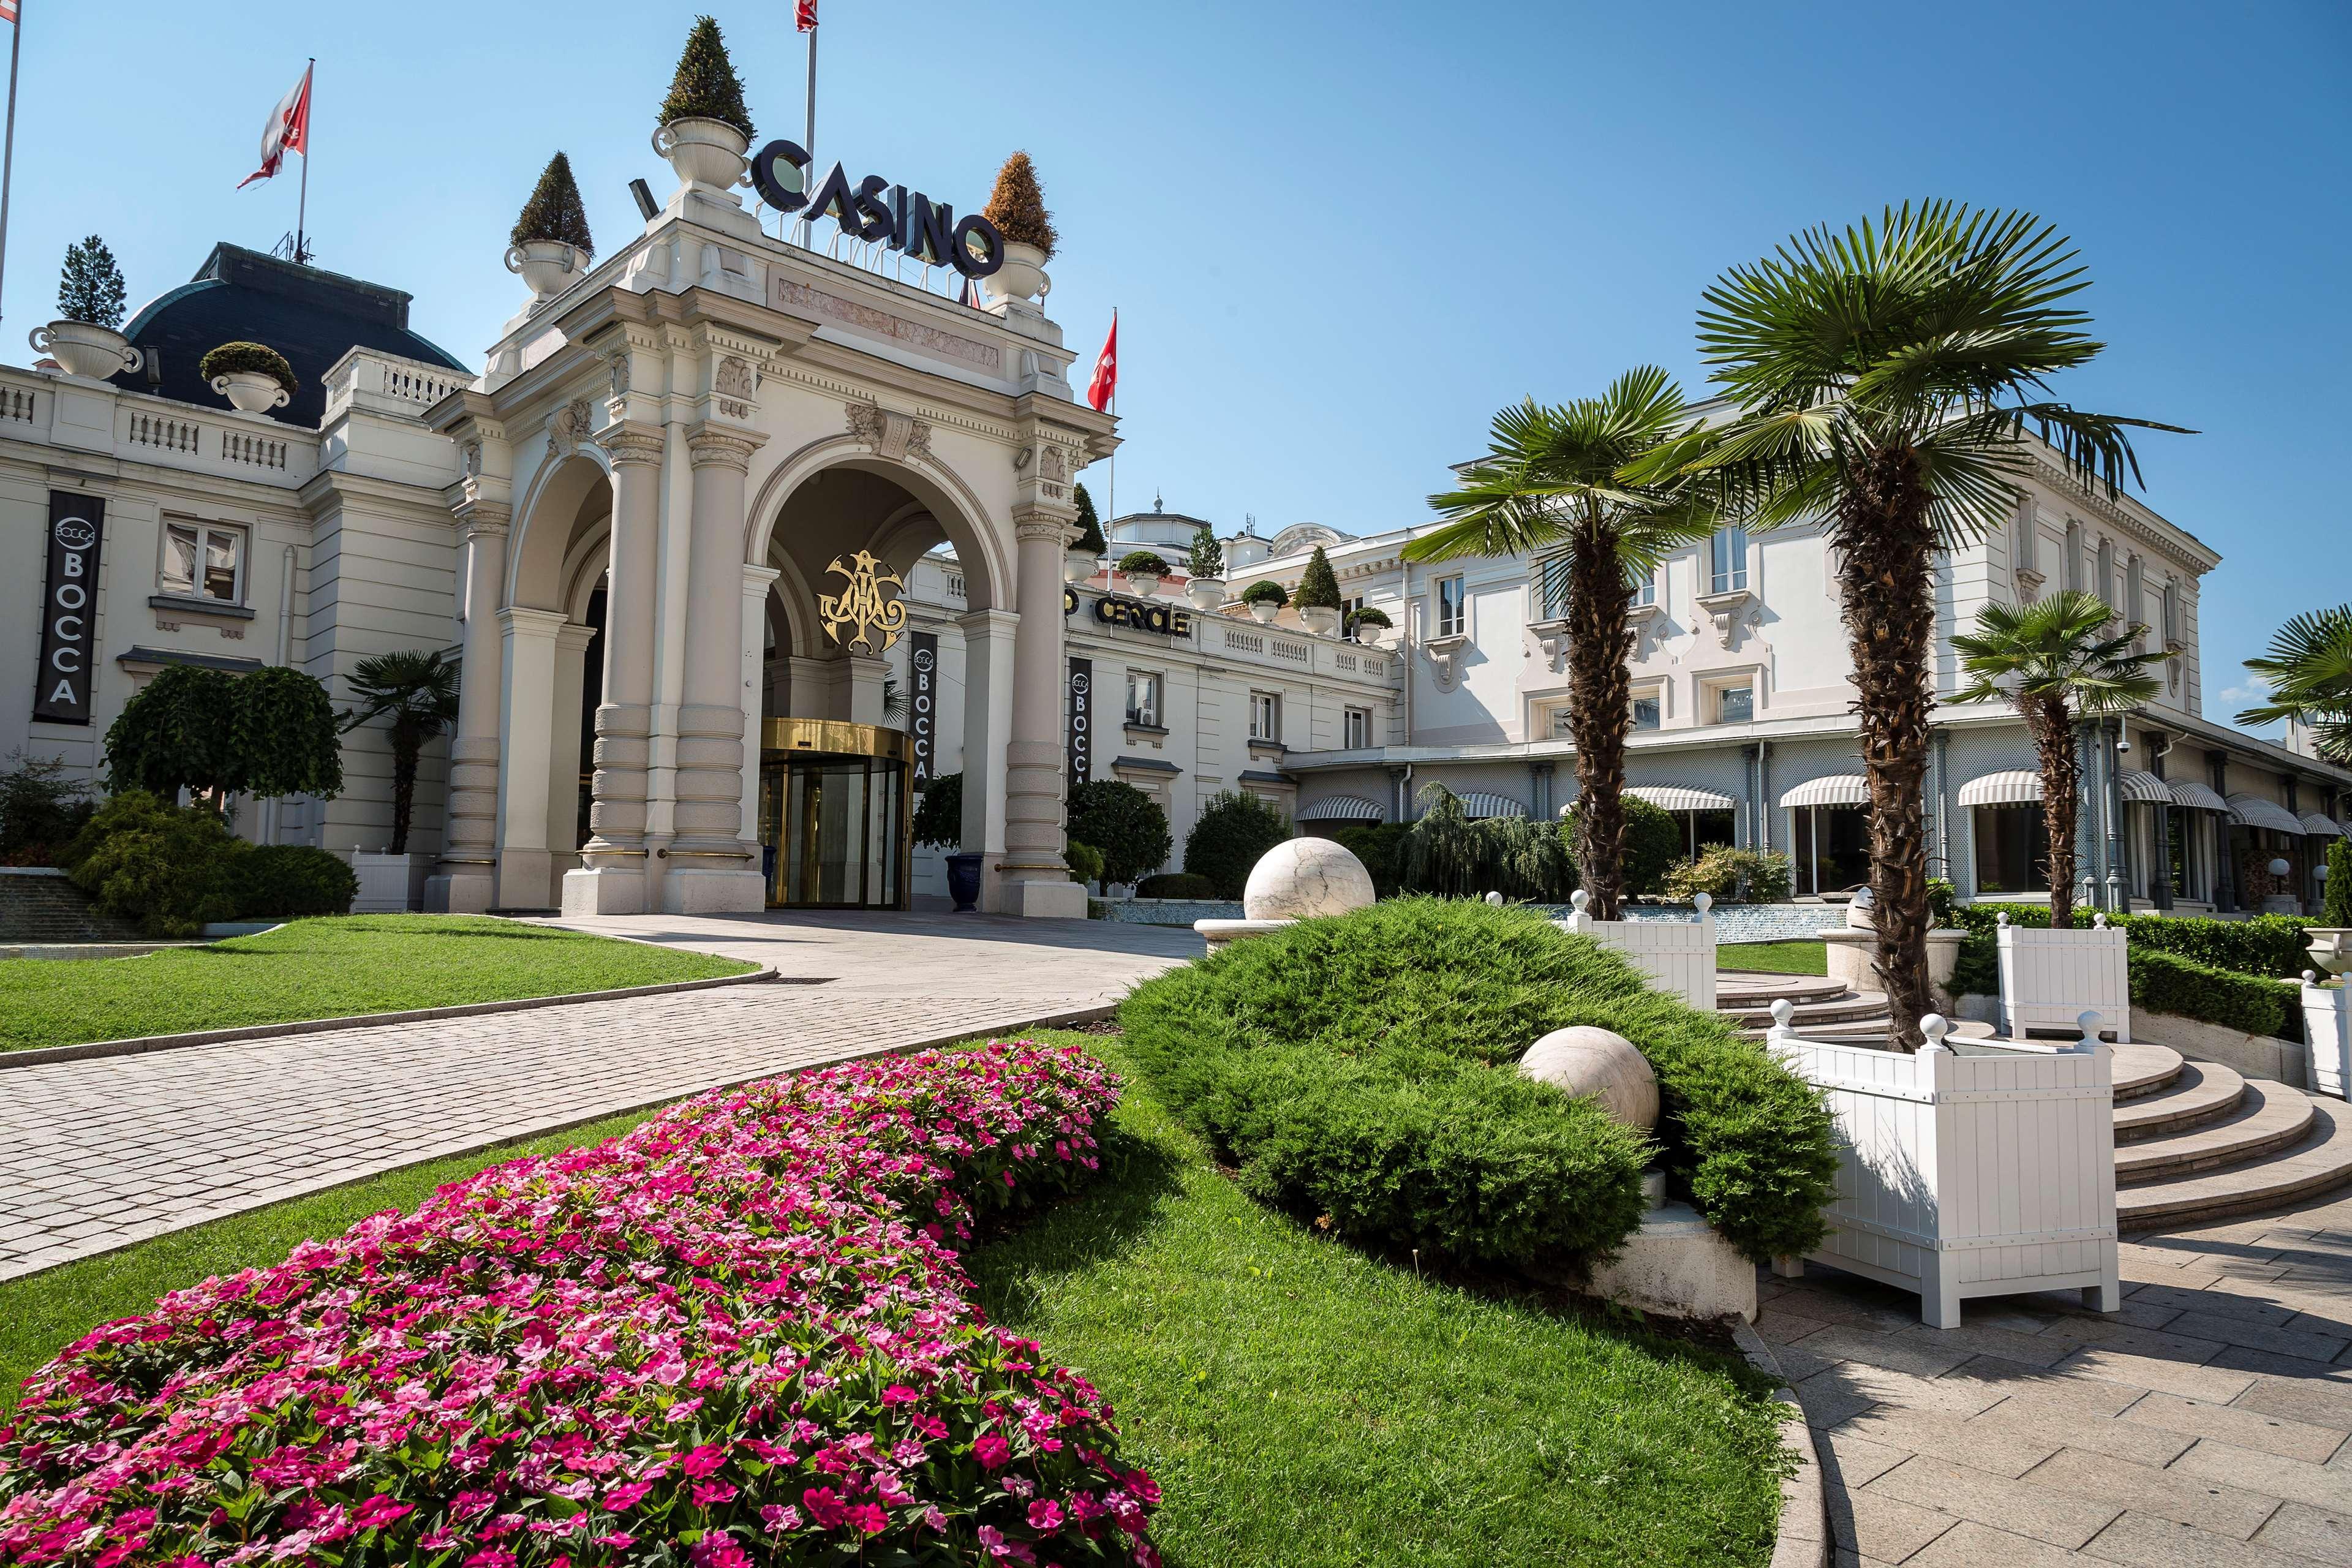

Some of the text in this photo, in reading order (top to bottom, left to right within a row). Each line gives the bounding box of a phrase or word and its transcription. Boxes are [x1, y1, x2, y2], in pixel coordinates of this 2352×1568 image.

[751, 140, 1005, 280] CASINO
[56, 526, 95, 543] BOCCA
[50, 552, 86, 704] BOCCA
[1095, 597, 1191, 638] CERCLE
[914, 674, 930, 778] BOCCA
